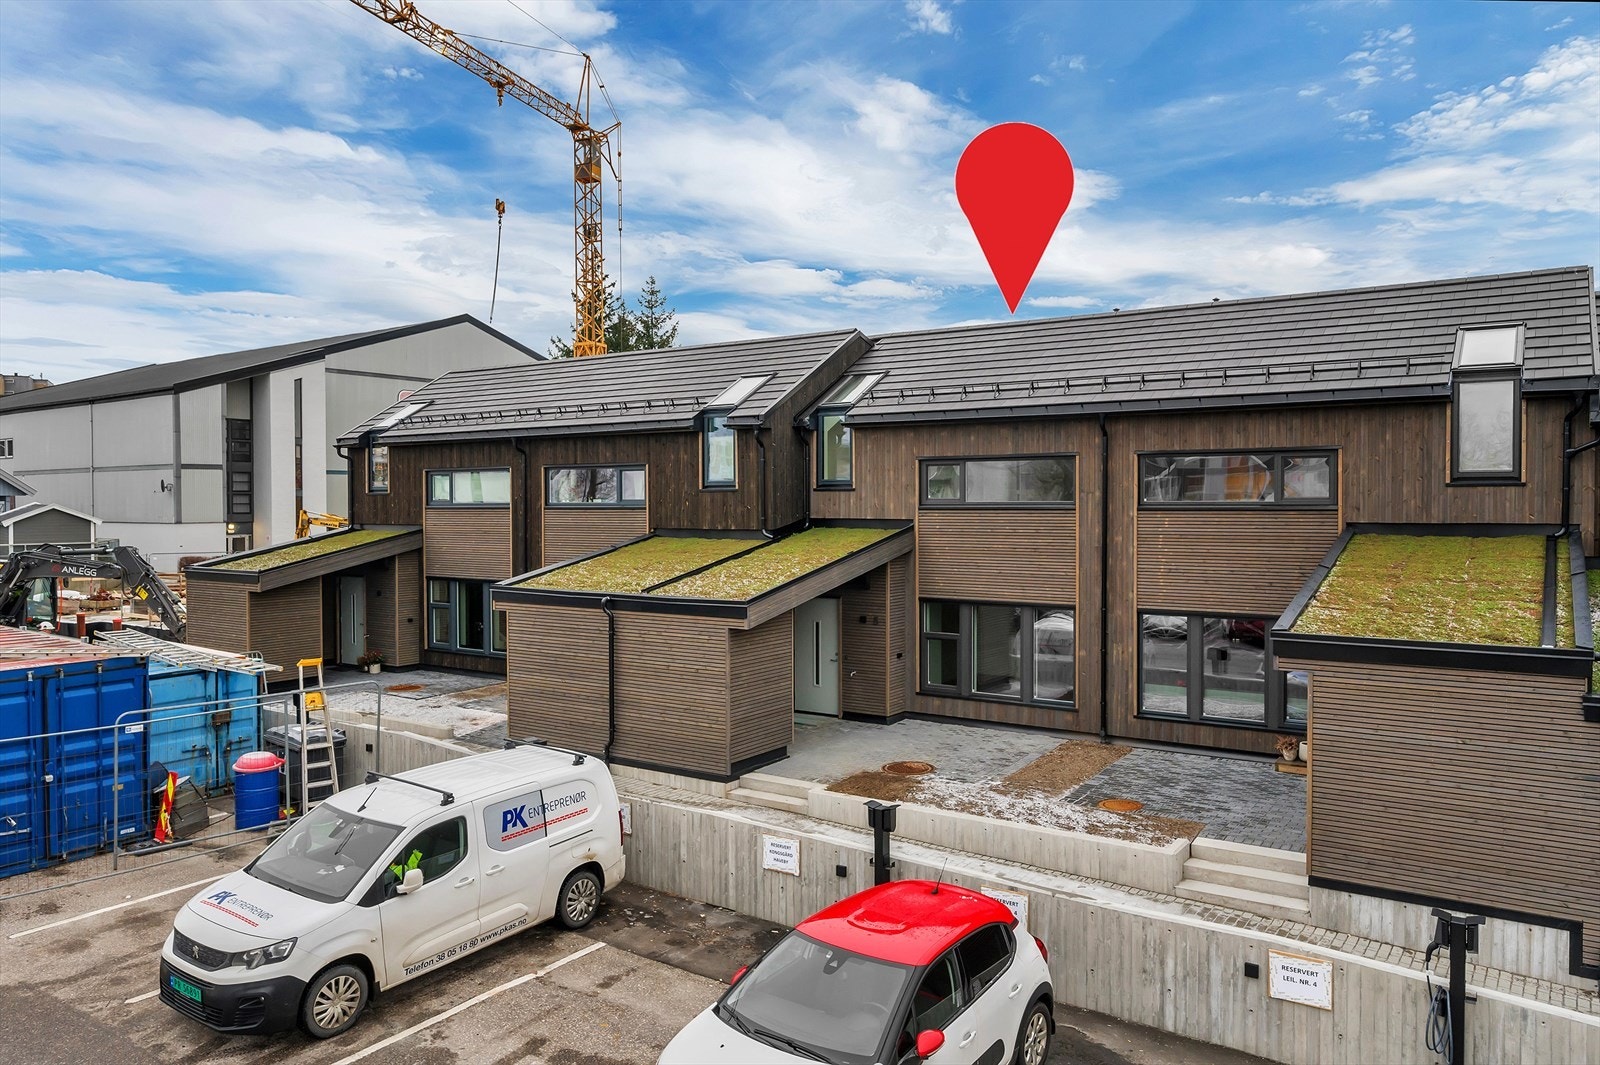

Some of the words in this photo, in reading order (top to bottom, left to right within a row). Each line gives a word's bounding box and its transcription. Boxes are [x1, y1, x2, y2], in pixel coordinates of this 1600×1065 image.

[61, 565, 97, 577] ANLEGG
[501, 804, 529, 833] PK
[527, 790, 587, 819] ENTREPRENØR
[770, 842, 791, 850] RESERVERT
[207, 890, 237, 905] PK
[227, 897, 274, 921] ENTREPRENØR
[404, 958, 434, 976] Telefon
[435, 952, 446, 963] 38
[446, 948, 457, 958] 05
[458, 943, 468, 953] 18
[468, 938, 479, 949] 80
[479, 918, 527, 944] www.pkas.no
[1281, 965, 1319, 978] RESERVERT
[1282, 975, 1298, 983] LEIL.
[1299, 979, 1311, 987] NR.
